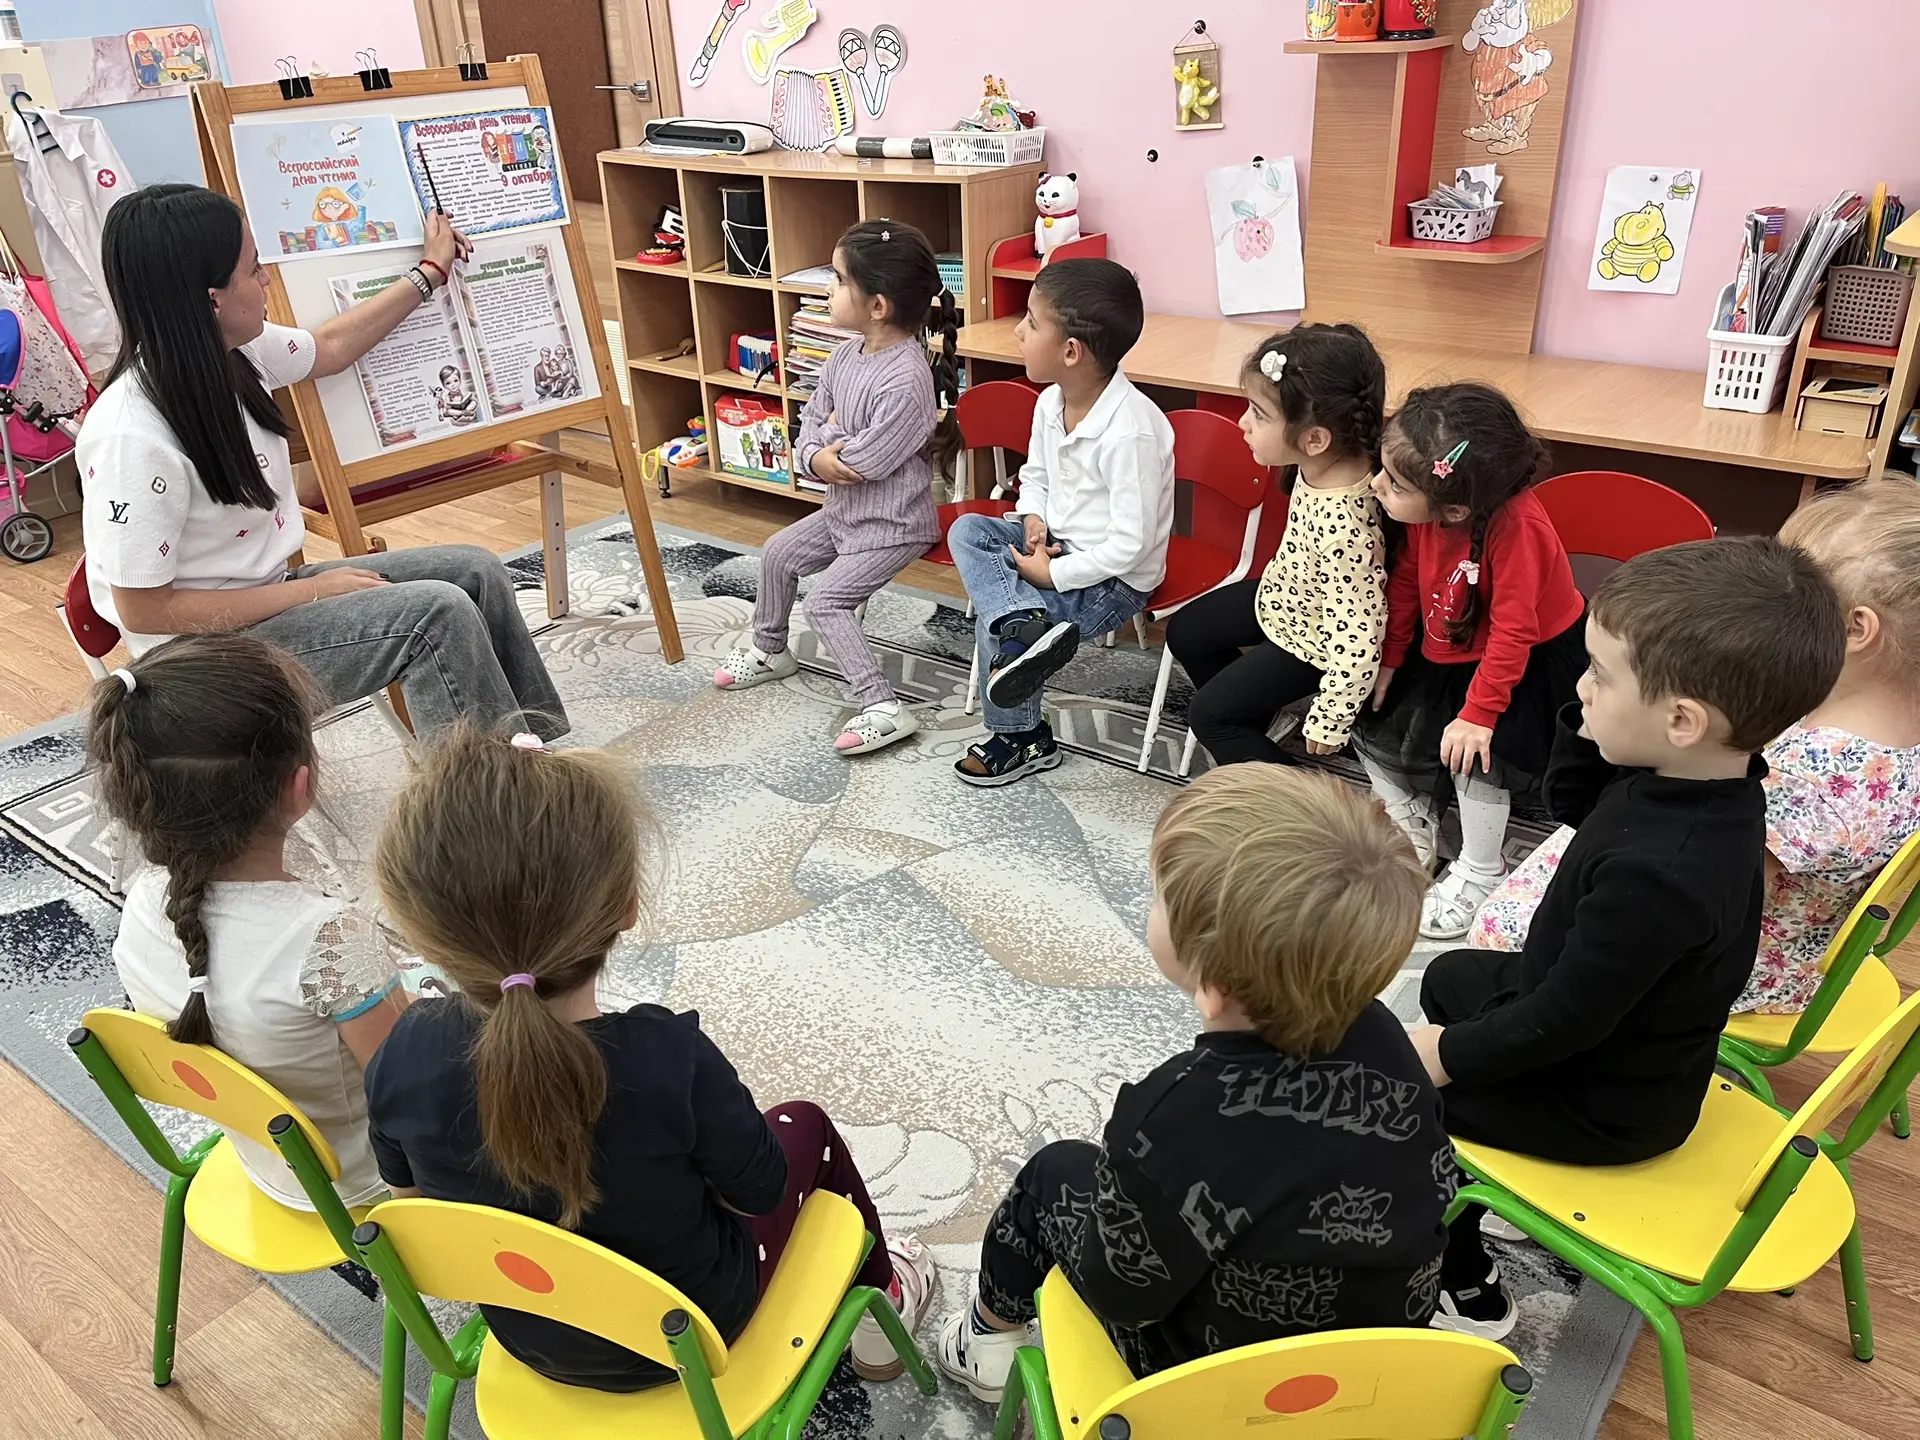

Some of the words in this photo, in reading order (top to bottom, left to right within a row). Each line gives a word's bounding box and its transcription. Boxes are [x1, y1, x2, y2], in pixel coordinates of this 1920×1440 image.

[168, 31, 200, 48] 104
[414, 117, 477, 138] Всероссийский
[479, 117, 499, 131] день
[500, 113, 532, 126] чтения
[278, 154, 360, 176] Всероссийский
[500, 174, 508, 187] 9
[512, 169, 553, 185] октября
